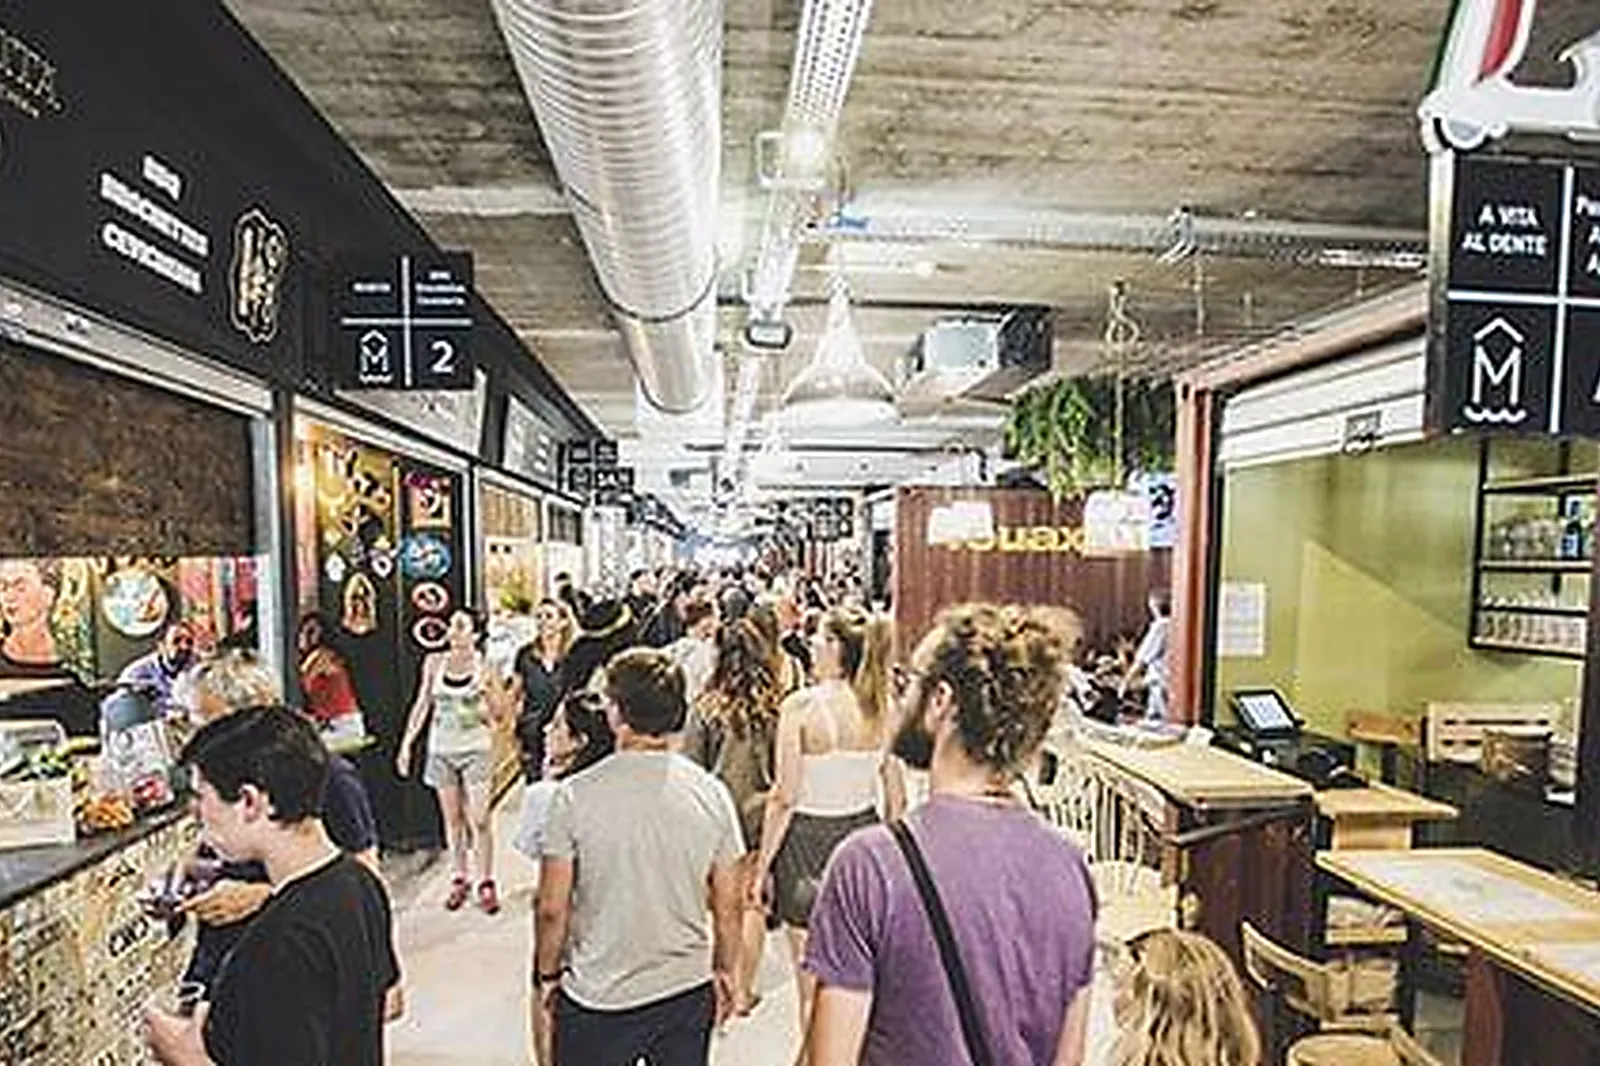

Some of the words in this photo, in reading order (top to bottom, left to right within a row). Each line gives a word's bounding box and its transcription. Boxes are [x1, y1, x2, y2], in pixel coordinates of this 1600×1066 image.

[1479, 205, 1494, 225] A
[1488, 233, 1547, 256] DENTE
[432, 340, 454, 373] 2
